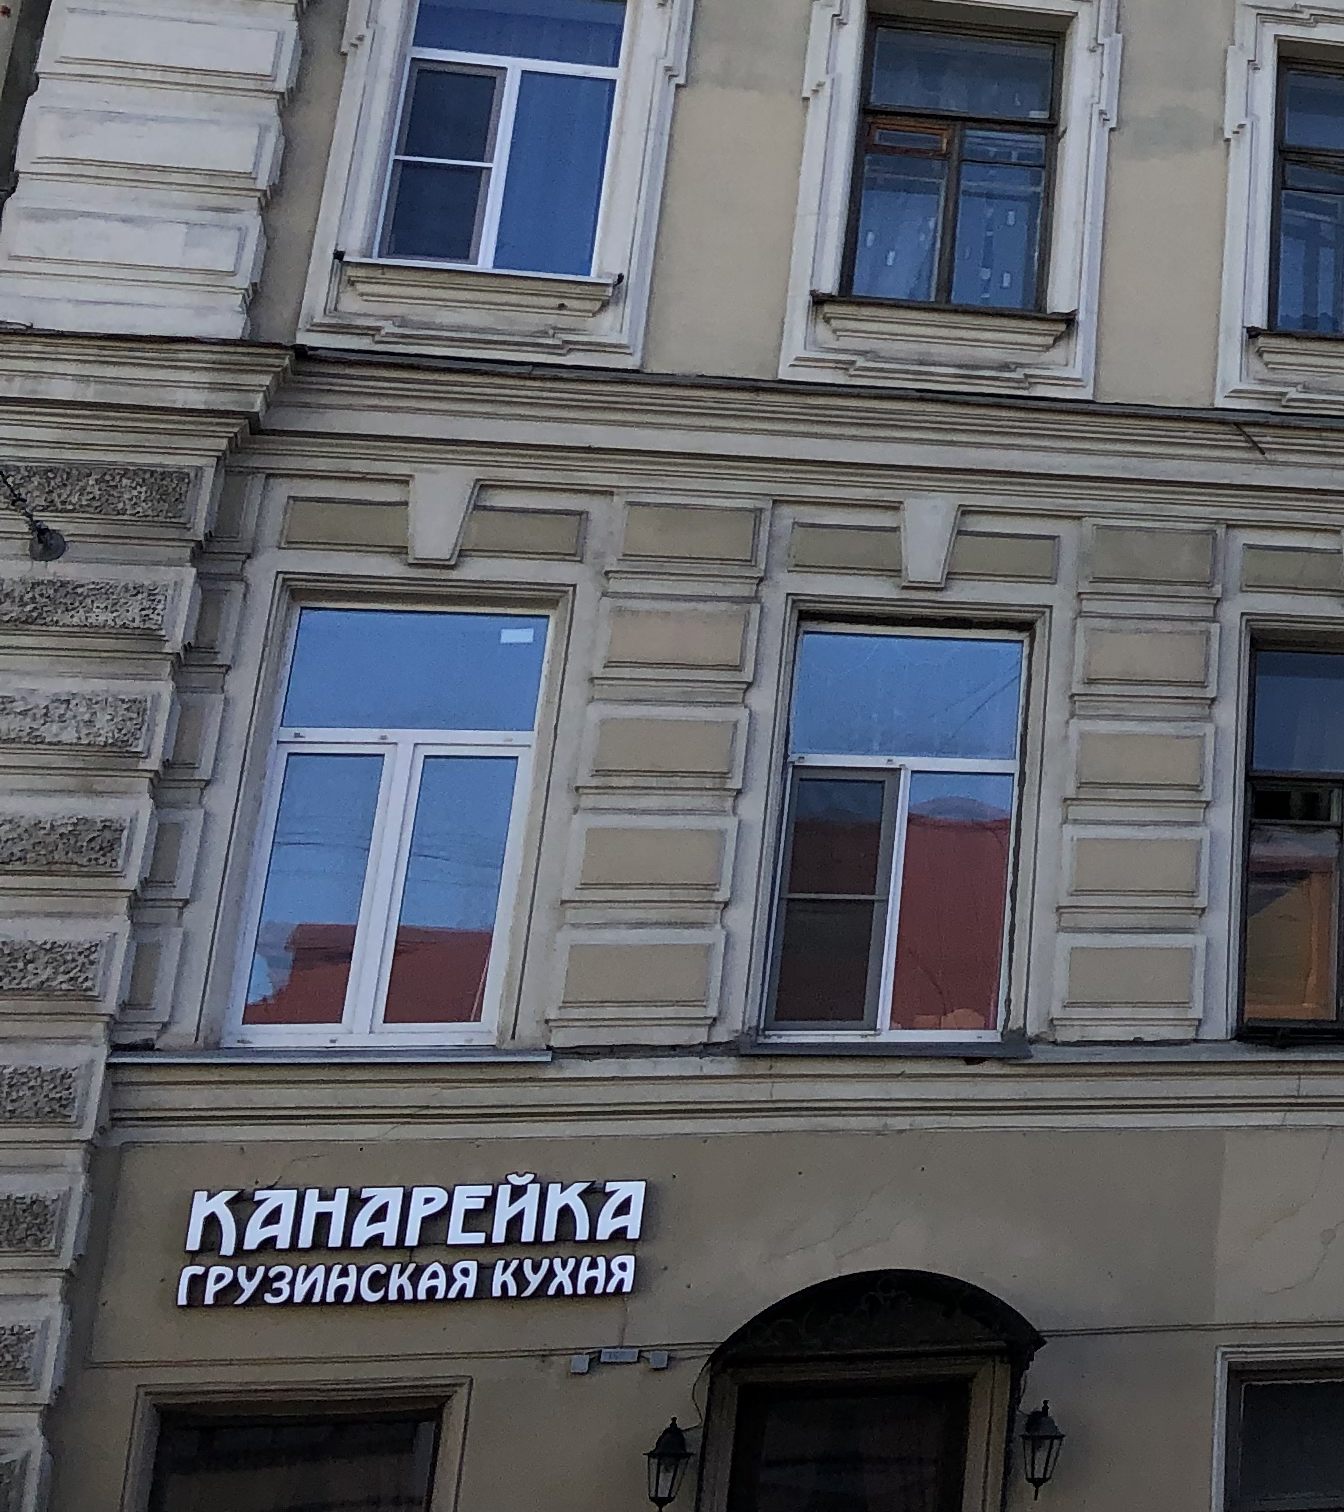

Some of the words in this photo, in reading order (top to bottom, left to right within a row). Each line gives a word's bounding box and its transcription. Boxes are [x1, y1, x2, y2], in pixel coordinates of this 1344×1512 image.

[184, 1172, 648, 1257] КАНАРЕЙКА
[176, 1259, 479, 1307] ГРУЗИНСКАЯ
[491, 1254, 636, 1298] КУХНЯ
